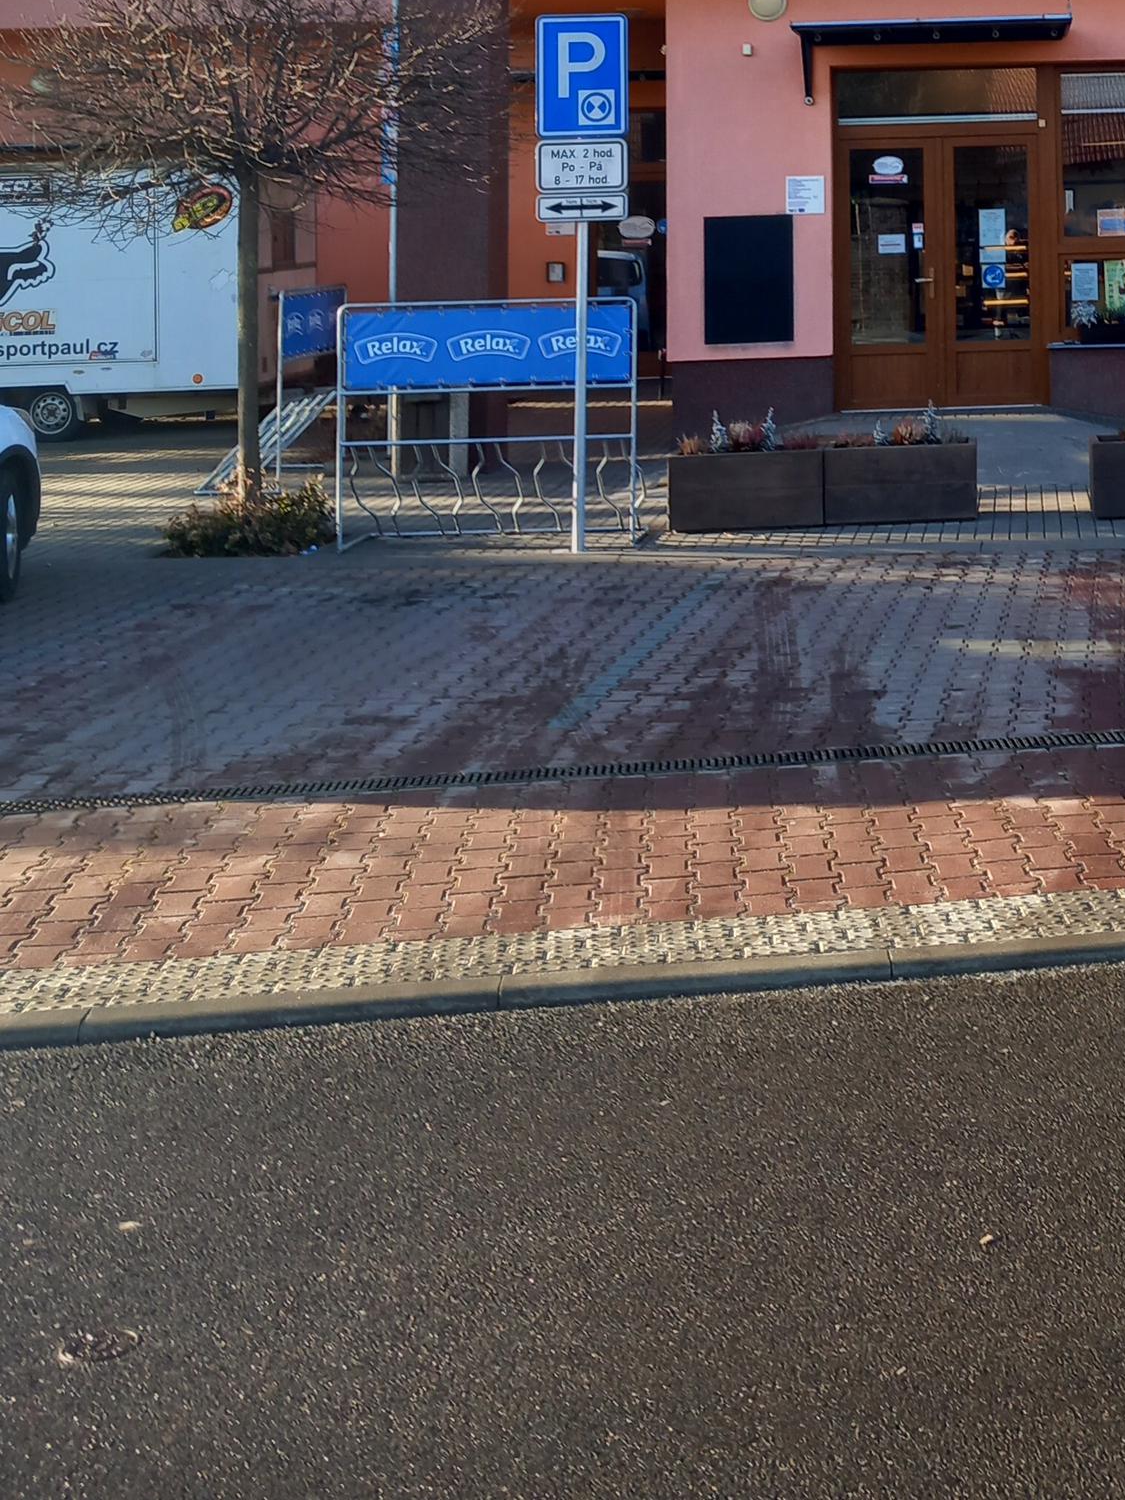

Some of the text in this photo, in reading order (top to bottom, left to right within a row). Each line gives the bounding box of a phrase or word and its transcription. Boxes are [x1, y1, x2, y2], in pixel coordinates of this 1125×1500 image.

[557, 31, 606, 99] P
[582, 148, 590, 158] 2
[561, 162, 576, 172] Po
[589, 160, 603, 171] Pá
[554, 175, 561, 185] 8
[575, 175, 585, 185] 17
[0, 338, 119, 360] portpaulcz
